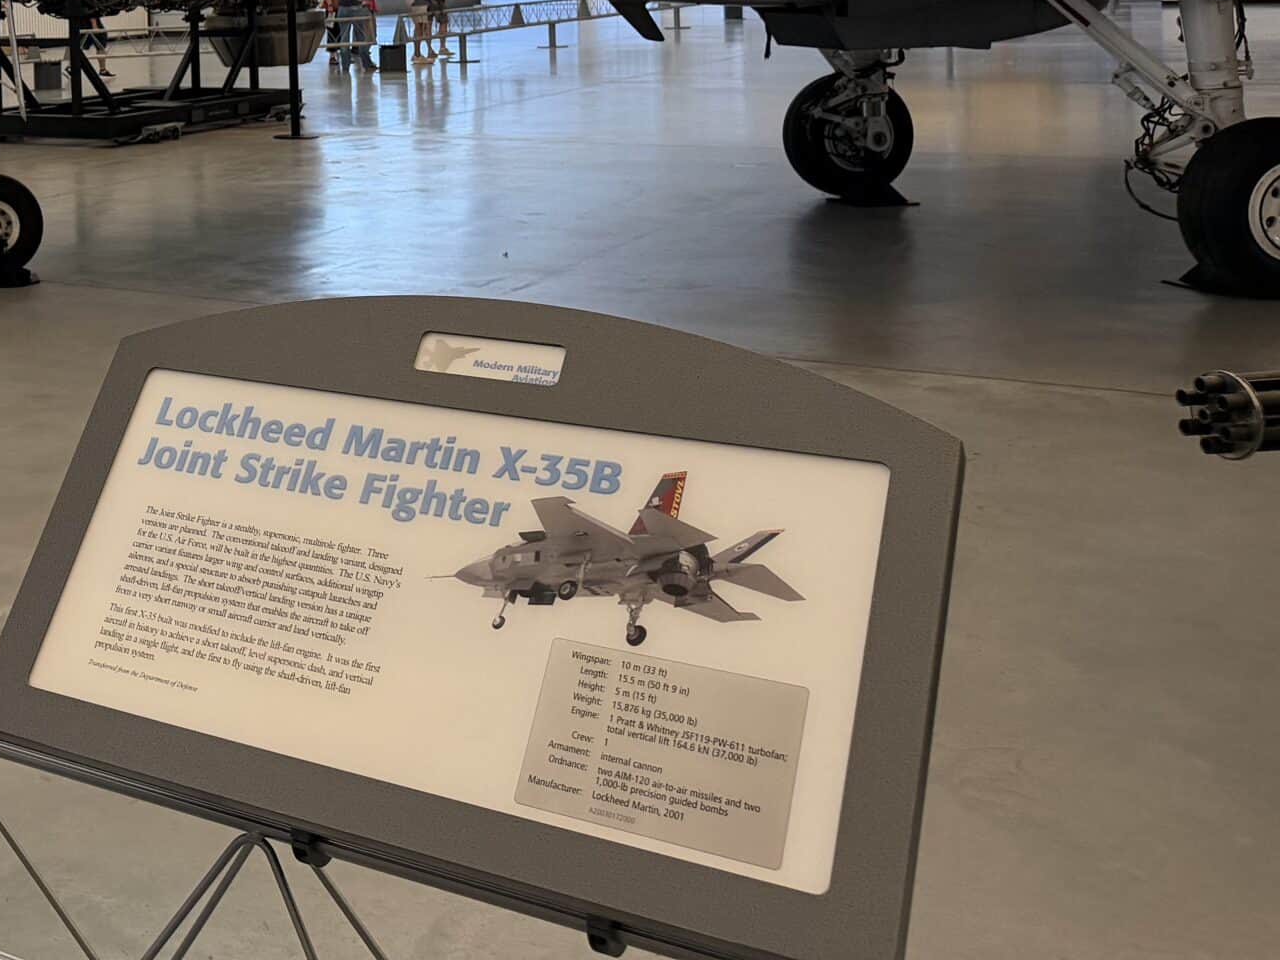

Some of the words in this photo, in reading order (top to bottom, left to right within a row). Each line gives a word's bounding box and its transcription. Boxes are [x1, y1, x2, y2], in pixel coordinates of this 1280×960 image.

[472, 359, 514, 372] Modern
[516, 364, 560, 380] Military
[155, 397, 336, 451] Lockheed
[342, 425, 480, 474] Martin
[493, 446, 623, 495] X-35B
[138, 436, 228, 478] Joint
[235, 452, 348, 499] Strike
[359, 472, 512, 527] Fighter
[670, 479, 684, 518] STOVL
[146, 505, 159, 515] The
[175, 512, 196, 522] Strike
[196, 515, 221, 527] Fighter
[221, 520, 227, 528] is
[337, 542, 362, 555] fighter.
[367, 548, 389, 560] Three
[212, 531, 225, 540] The
[225, 536, 270, 549] conventional
[296, 549, 311, 557] and
[311, 550, 339, 565] landing
[340, 558, 367, 569] variant,
[368, 562, 403, 576] designed
[147, 530, 158, 539] the
[159, 532, 173, 542] U.S.
[174, 536, 187, 545] Air
[187, 538, 208, 551] Force,
[210, 543, 224, 552] will
[223, 545, 232, 554] be
[233, 547, 250, 558] built
[259, 552, 271, 562] the
[271, 554, 298, 567] highest
[339, 568, 354, 579] The
[355, 571, 371, 582] U.S.
[104, 617, 128, 627] aircraft
[136, 621, 159, 636] history
[160, 629, 168, 637] to
[168, 631, 195, 643] achieve
[201, 637, 219, 649] short
[248, 648, 267, 661] level
[267, 655, 307, 670] supersonic
[307, 662, 326, 675] dash,
[328, 670, 344, 679] and
[345, 673, 374, 686] vertical
[110, 602, 124, 613] This
[124, 606, 138, 617] first
[138, 609, 157, 621] X-35
[157, 613, 173, 625] built
[188, 623, 221, 636] modified
[221, 630, 229, 638] to
[229, 632, 256, 644] include
[257, 637, 269, 647] the
[326, 652, 333, 662] It
[351, 659, 364, 669] the
[365, 662, 381, 673] first
[572, 650, 612, 666] Wingspan:
[622, 660, 631, 670] 10
[632, 664, 641, 672] m
[643, 665, 656, 675] (33
[658, 667, 667, 679] ft)
[580, 665, 608, 679] Length:
[619, 674, 635, 685] 15.5
[637, 679, 646, 687] m
[647, 680, 661, 690] (50
[662, 683, 669, 692] ft
[671, 685, 678, 693] 9
[679, 686, 690, 697] in)
[573, 691, 603, 706] Weight:
[613, 701, 639, 714] 15,876
[641, 707, 652, 719] kg
[653, 709, 685, 724] (35,000
[686, 716, 698, 728] lb)
[578, 679, 605, 693] Height:
[615, 687, 621, 696] 5
[622, 690, 630, 698] m
[632, 691, 646, 701] (15
[647, 694, 657, 704] ft)
[571, 706, 600, 719] Engine:
[610, 714, 614, 722] 1
[616, 716, 636, 728] Pratt
[638, 721, 644, 730] &
[646, 722, 680, 739] Whitney
[681, 730, 745, 752] JSF119-PW-611
[748, 746, 788, 762] turbofan;
[571, 731, 594, 743] Crew:
[604, 738, 608, 746] 1
[607, 725, 626, 736] total
[627, 730, 657, 744] vertical
[658, 735, 670, 746] lift
[673, 738, 695, 752] 164.6
[697, 744, 710, 755] kN
[711, 748, 744, 763] (37,000
[746, 755, 758, 767] lb)
[547, 740, 591, 757] Armament:
[600, 752, 632, 767] internal
[632, 761, 663, 774] cannon
[528, 774, 582, 794] Manufacturer:
[592, 790, 630, 808] Lockheed
[631, 800, 661, 816] Martin,
[663, 808, 684, 821] 2001
[548, 754, 588, 771] Ordnance:
[597, 767, 613, 778] two
[614, 770, 650, 786] AIM-120
[651, 781, 688, 795] air-to-air
[689, 789, 723, 804] missiles
[724, 798, 742, 808] and
[744, 801, 761, 813] two
[596, 776, 628, 792] 1,000-lb
[629, 786, 667, 801] precision
[668, 796, 698, 809] guided
[699, 801, 728, 817] bombs
